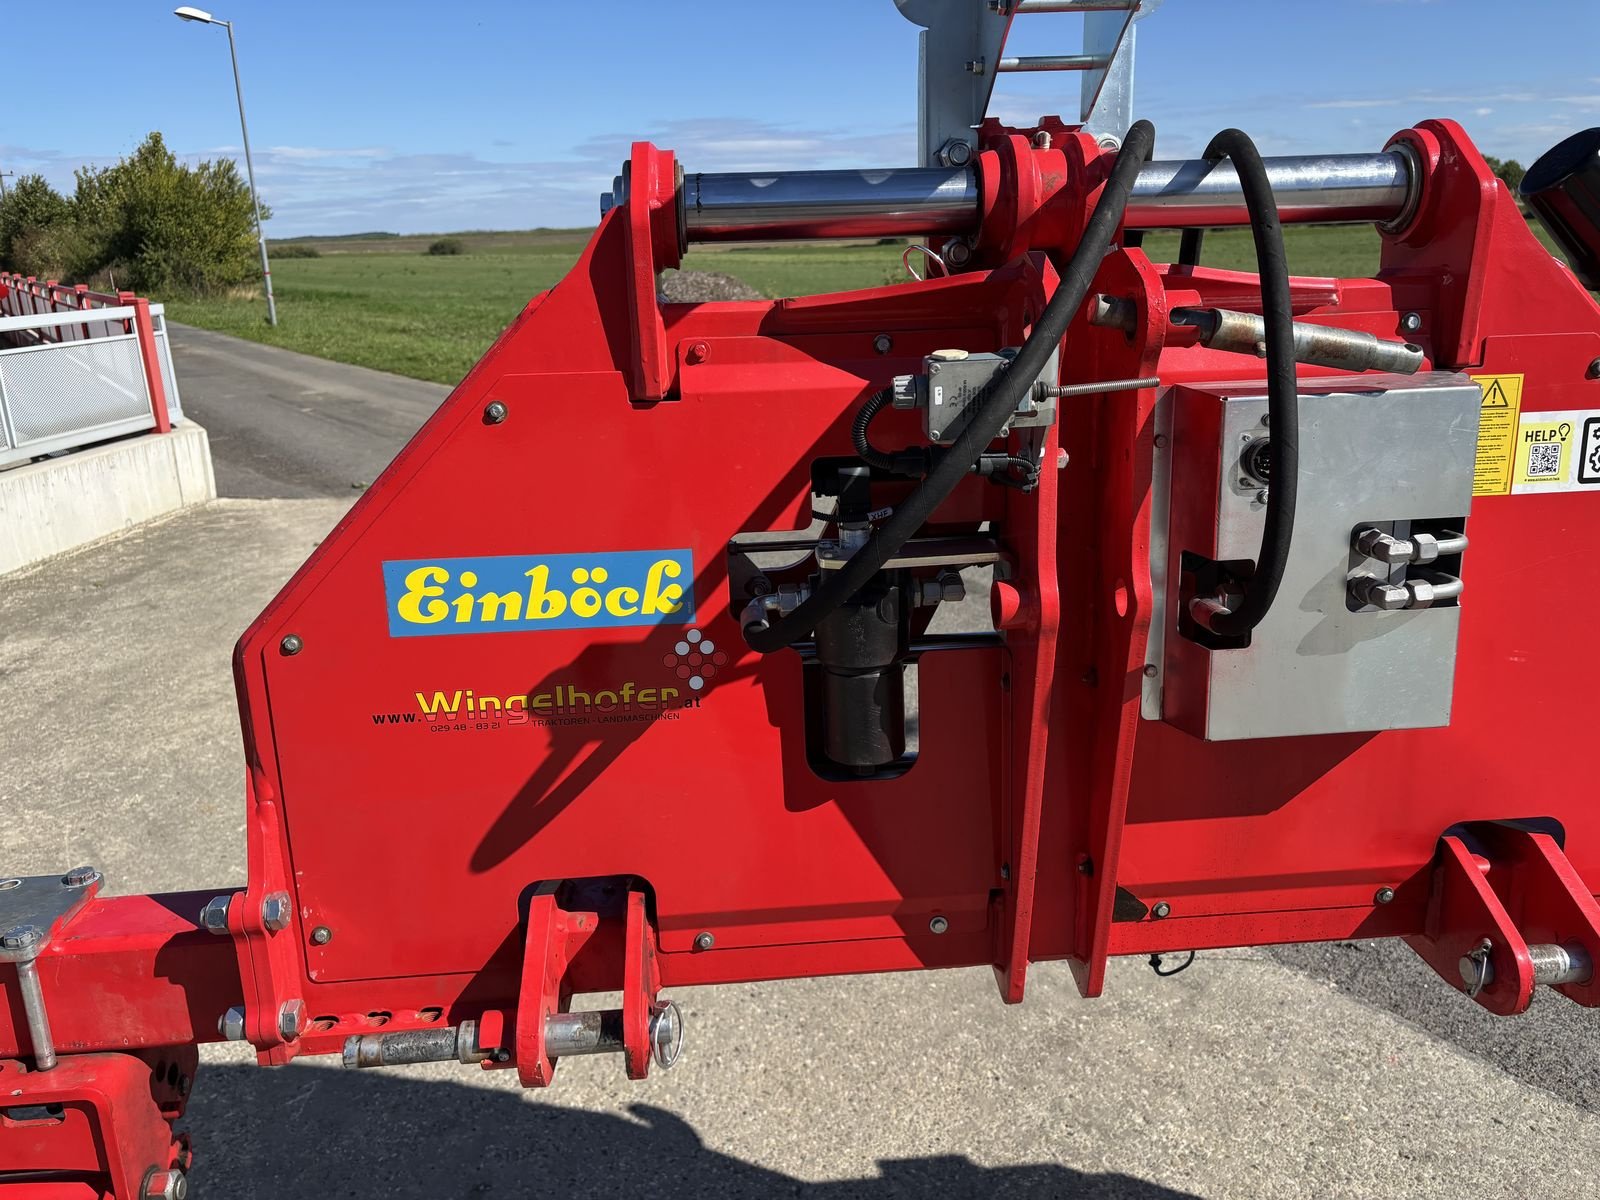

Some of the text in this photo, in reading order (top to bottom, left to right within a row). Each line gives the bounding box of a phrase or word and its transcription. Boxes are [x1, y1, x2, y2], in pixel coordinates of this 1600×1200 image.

[1525, 429, 1557, 442] HELP
[397, 559, 683, 624] Einböck
[372, 682, 701, 725] www.Wingelhofer.at
[430, 724, 451, 733] 029
[453, 723, 467, 731] 48
[475, 722, 489, 730] 83
[531, 717, 590, 728] TRAKTOREN
[597, 712, 680, 724] LANDMASCHINEN
